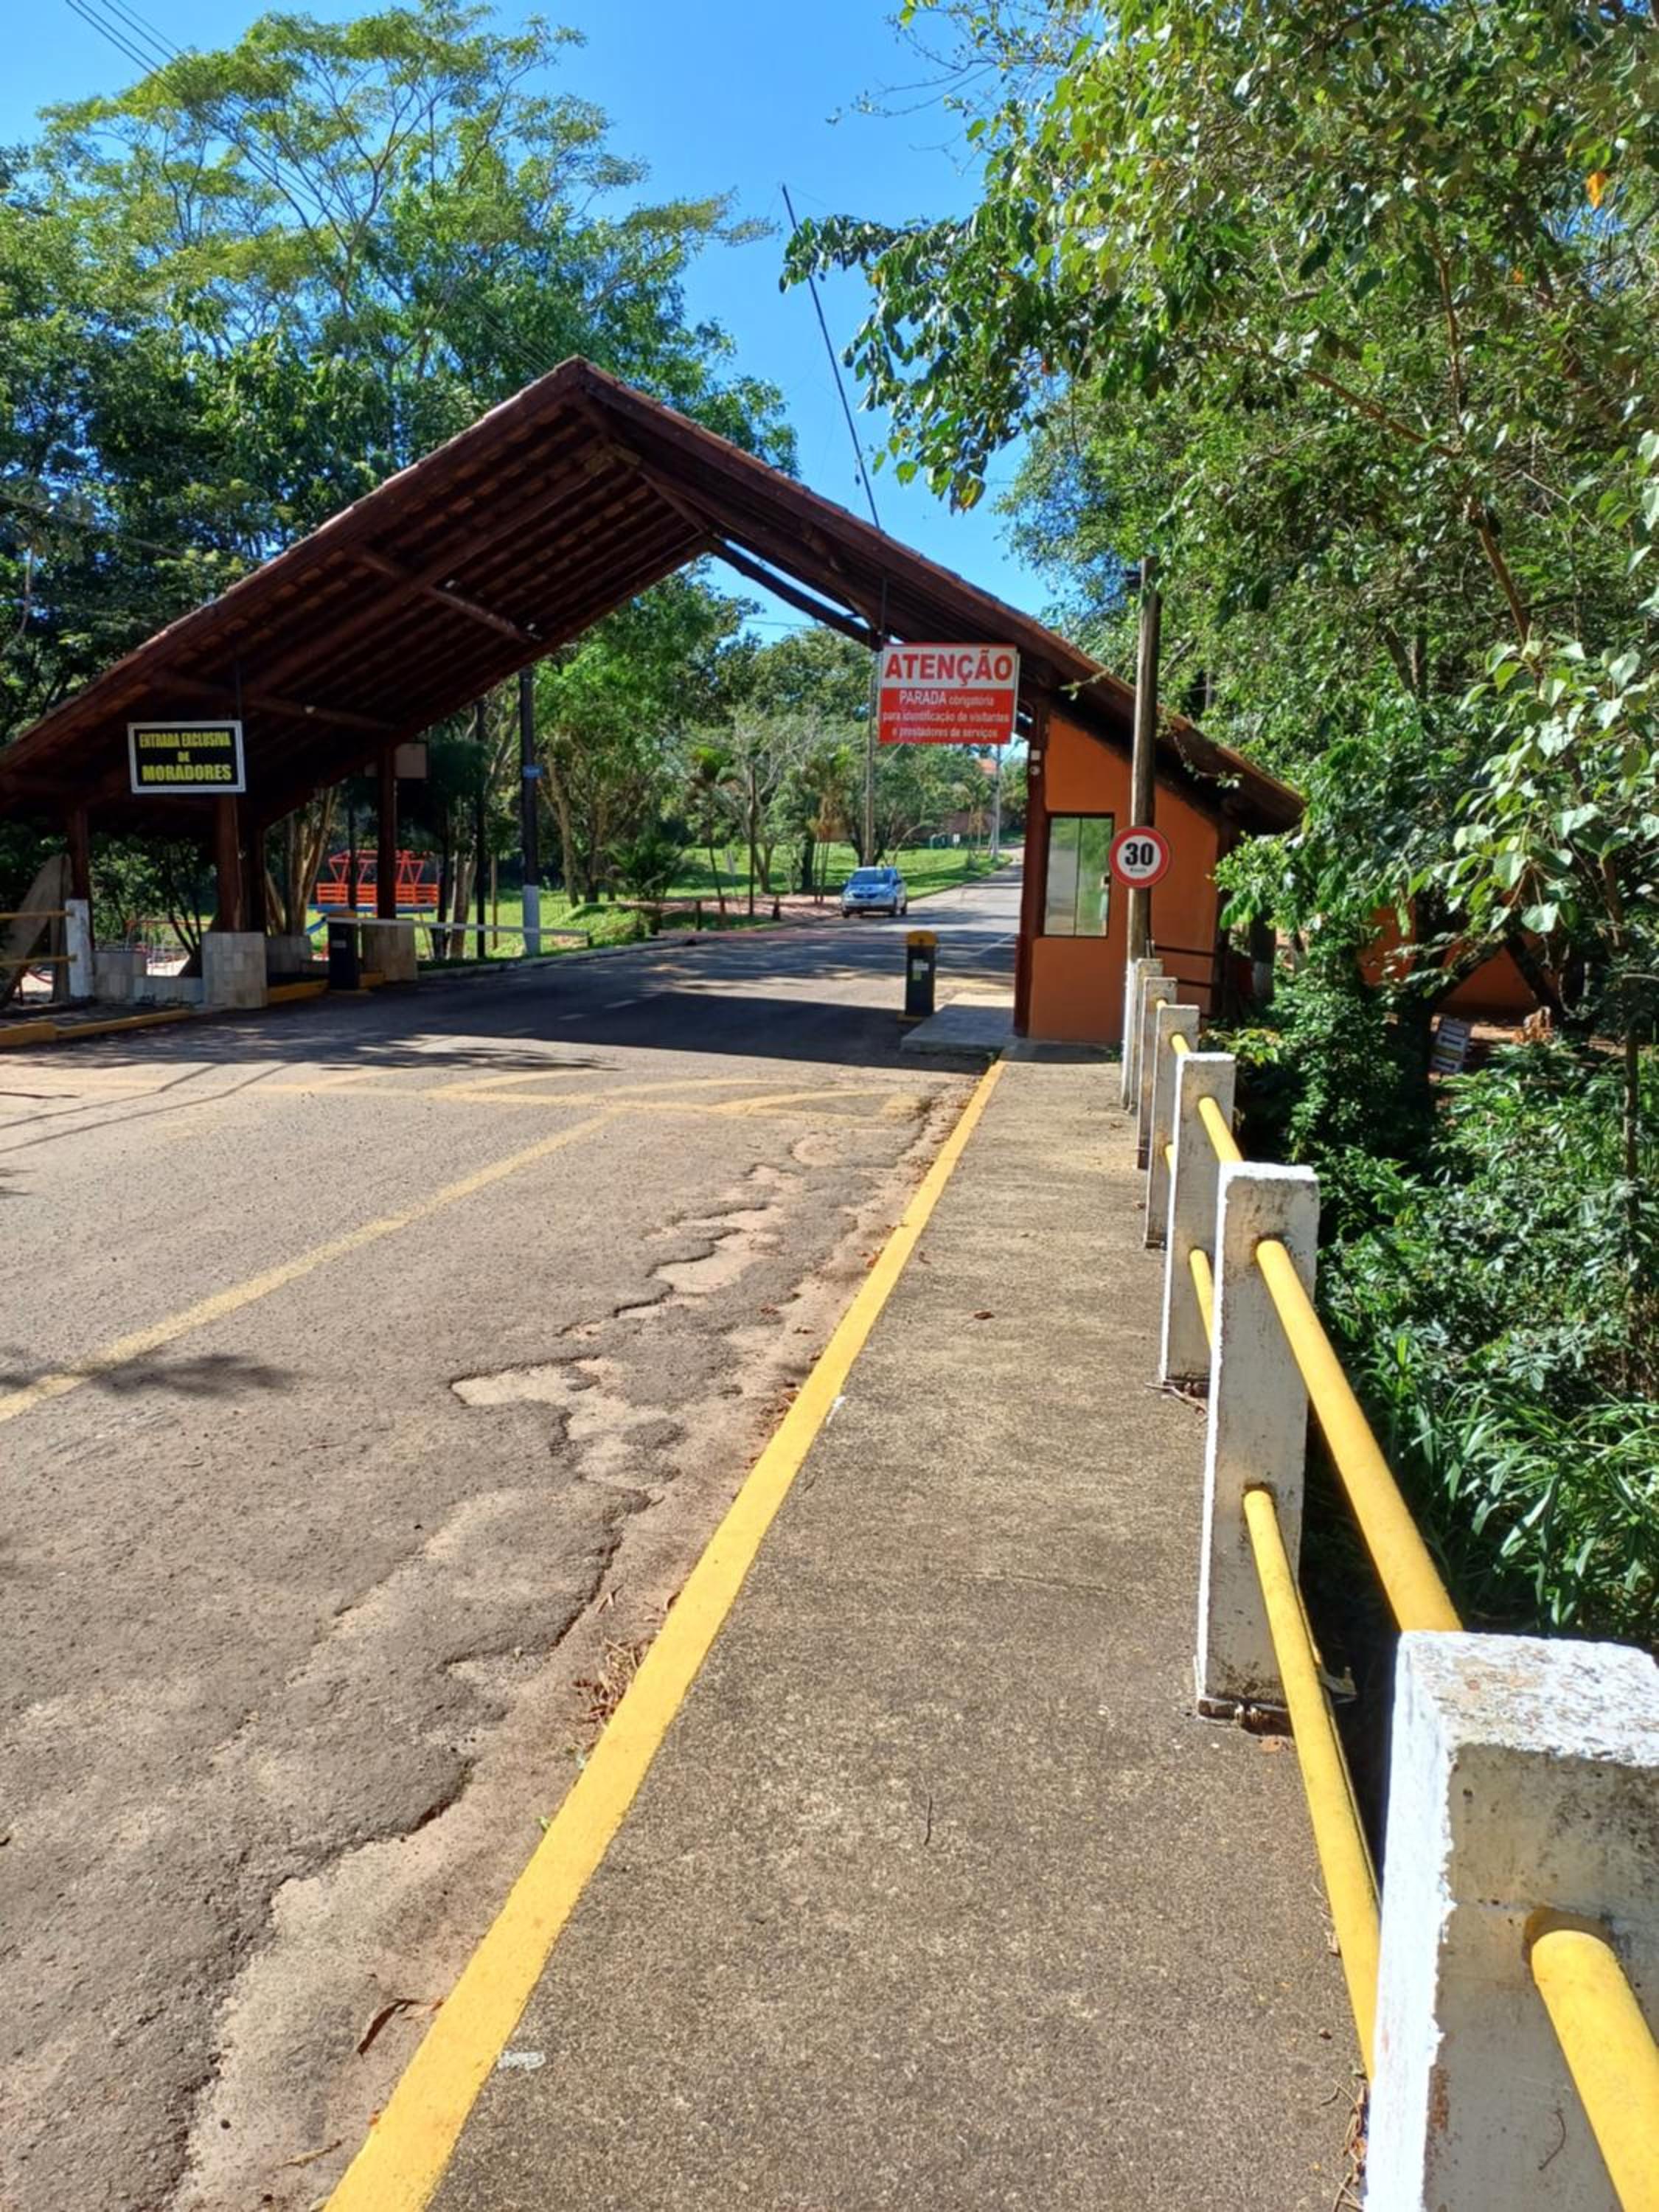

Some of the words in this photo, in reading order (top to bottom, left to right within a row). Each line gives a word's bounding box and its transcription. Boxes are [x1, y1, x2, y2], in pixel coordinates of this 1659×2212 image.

[886, 650, 1012, 686] ATENÇÃO
[900, 689, 947, 705] PARADA
[957, 712, 968, 721] de
[139, 733, 181, 748] ENTRADA
[181, 731, 232, 748] EXCLUSIVA
[950, 727, 960, 737] de
[177, 751, 190, 762] DE
[142, 764, 232, 782] MORADORES
[1125, 842, 1155, 866] 30
